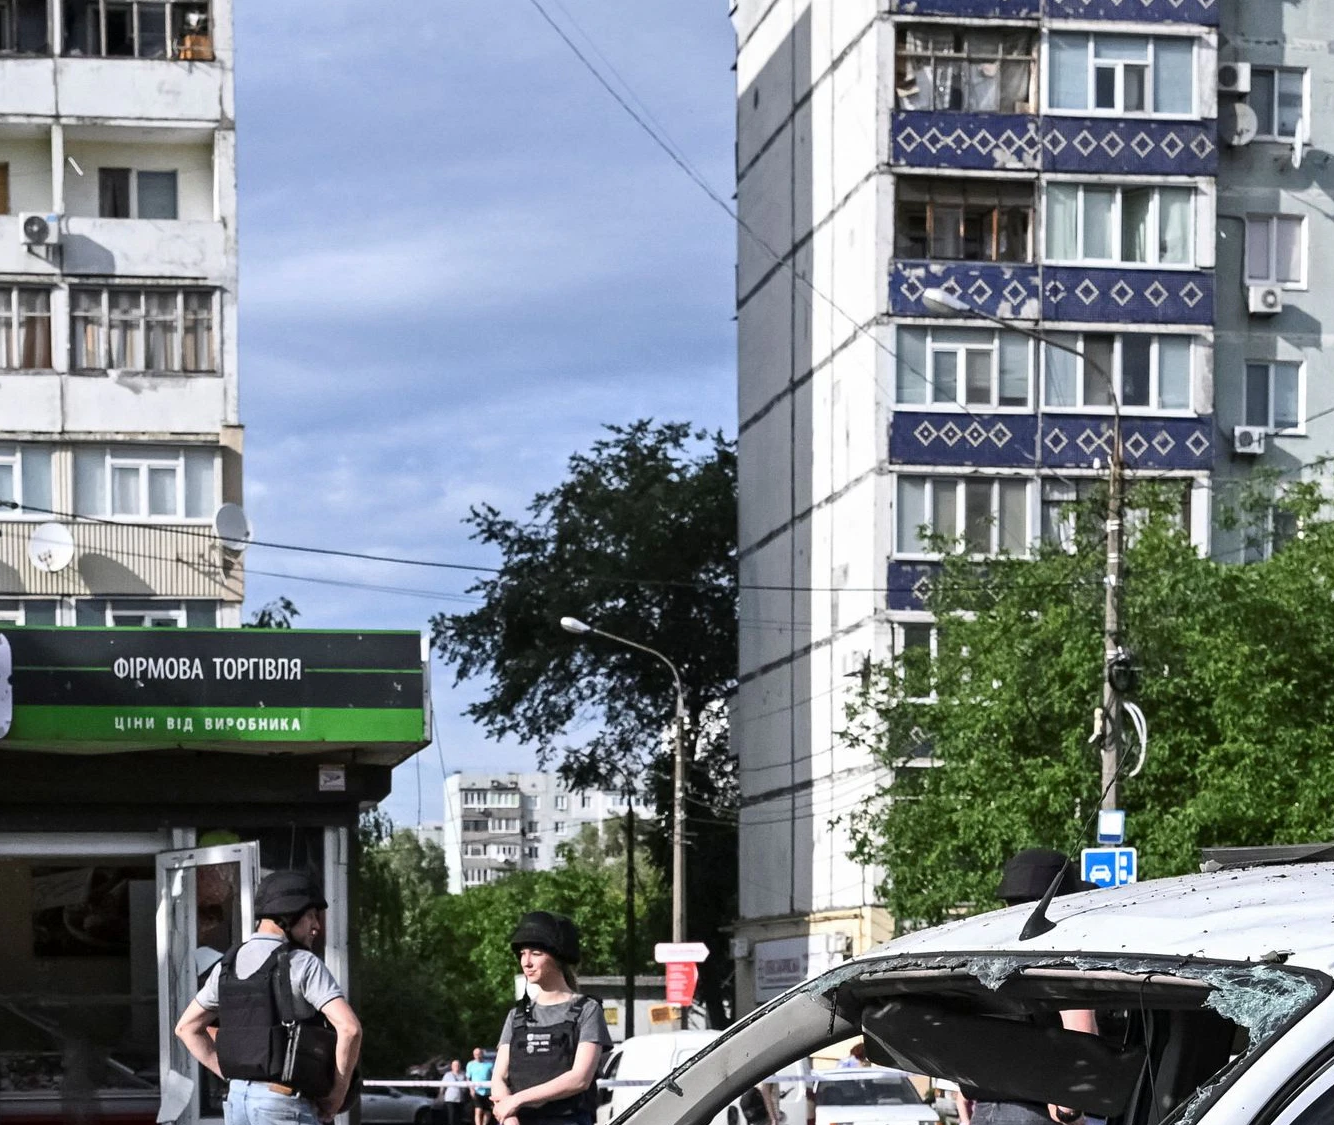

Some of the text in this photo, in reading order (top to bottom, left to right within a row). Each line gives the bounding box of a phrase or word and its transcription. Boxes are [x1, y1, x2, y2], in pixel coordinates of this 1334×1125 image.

[113, 657, 302, 681] ФІРМОВА ТОРГІВЛЯ
[114, 716, 301, 733] ЦІНИ ВІД ВИРОБНИКА
